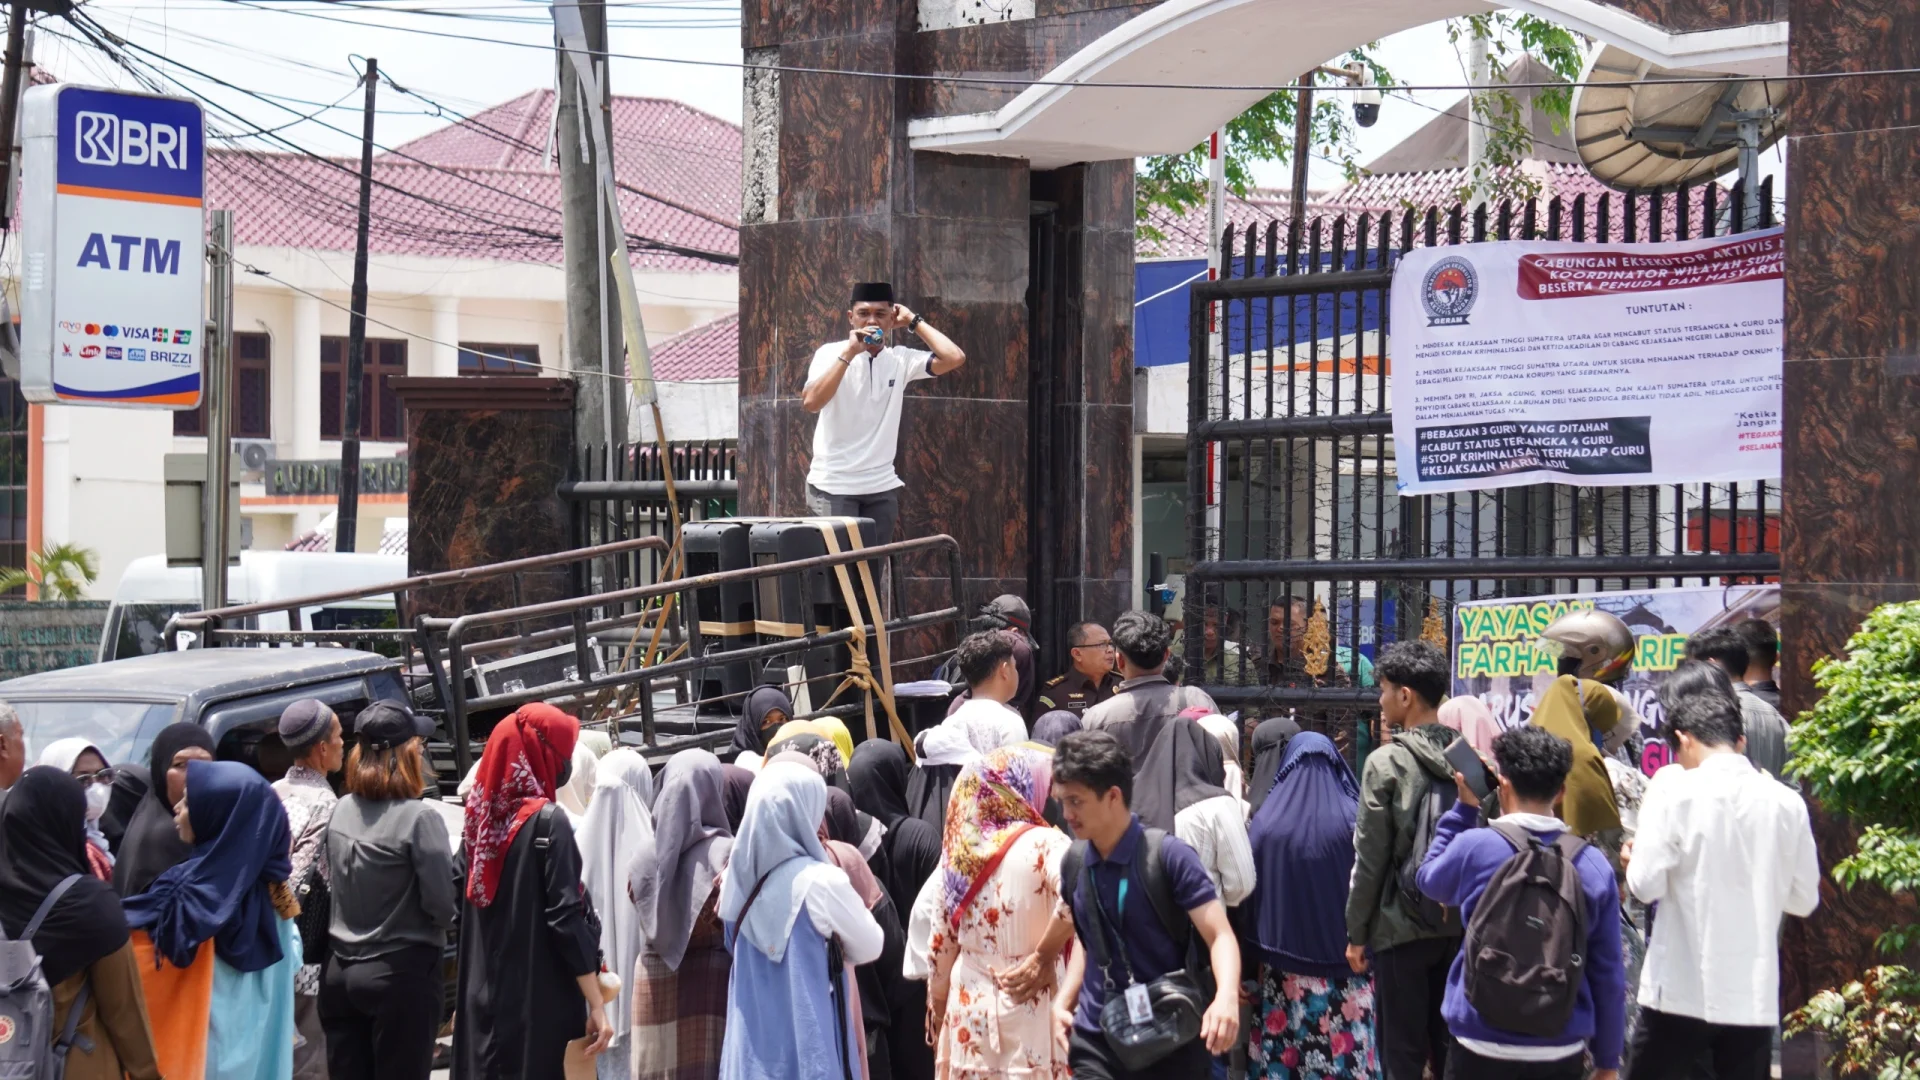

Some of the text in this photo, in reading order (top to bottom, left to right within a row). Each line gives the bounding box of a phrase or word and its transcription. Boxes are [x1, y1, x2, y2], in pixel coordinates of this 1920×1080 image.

[122, 119, 187, 170] BRI
[77, 232, 180, 275] ATM
[1534, 257, 1617, 268] GABUNGAN
[1622, 253, 1707, 267] EKSEKUTOR
[1713, 240, 1773, 259] AKTIVIS
[1550, 269, 1668, 280] KOORDINATOR
[1674, 259, 1741, 276] WILAYAH
[1538, 281, 1592, 294] BESERTA
[1598, 280, 1662, 290] PEMUDA
[1667, 276, 1702, 286] DAN
[1453, 298, 1469, 313] MUDA
[1626, 302, 1686, 315] TUNTUTAN
[122, 327, 150, 340] VISA
[1457, 339, 1498, 347] KEJAKSAAN
[1567, 333, 1591, 341] UTARA
[1614, 329, 1651, 338] MENCABUT
[1684, 323, 1730, 332] TERSANGKA
[1741, 319, 1764, 327] GURU
[1474, 346, 1526, 355] KRIMINALISASI
[1542, 342, 1601, 350] KETIDAKADILAN
[1612, 339, 1639, 347] CABANG
[1641, 335, 1683, 344] KEJAKSAAN
[1685, 333, 1712, 342] NEGERI
[1714, 330, 1753, 339] LABUHAN
[151, 351, 192, 363] BRIZZI
[1454, 365, 1497, 373] KEJAKSAAN
[1500, 363, 1525, 371] TINGGI
[1647, 354, 1695, 362] MENAHANAN
[1698, 350, 1739, 359] TERHADAP
[1742, 347, 1773, 356] OKNUM
[1526, 371, 1555, 379] KORUPSI
[1415, 404, 1446, 412] PENYIDIK
[1472, 399, 1511, 407] KEJAKSAAN
[1621, 393, 1656, 401] BERLAKU
[1704, 387, 1750, 396] MELANGGAR
[1752, 384, 1773, 392] KODE
[1423, 394, 1452, 402] MEMINTA
[1667, 381, 1707, 389] SUMATERA
[1739, 376, 1764, 384] UNTUK
[1440, 410, 1484, 419] MENJALANKAN
[1736, 419, 1777, 428] Jangan
[1420, 422, 1609, 440] #BEBASKAN 3 GURU YANG DITAHAN
[1420, 441, 1461, 453] #CABUT
[1464, 438, 1501, 450] STATUS
[1571, 437, 1578, 445] 4
[1582, 435, 1614, 445] GURU
[1420, 453, 1457, 464] #STOP
[1541, 447, 1608, 458] TERHADAP
[1611, 445, 1645, 456] GURU
[1421, 462, 1496, 476] #KEJAKSAAN
[1545, 459, 1570, 469] ADIL
[1459, 601, 1594, 641] YAYAS
